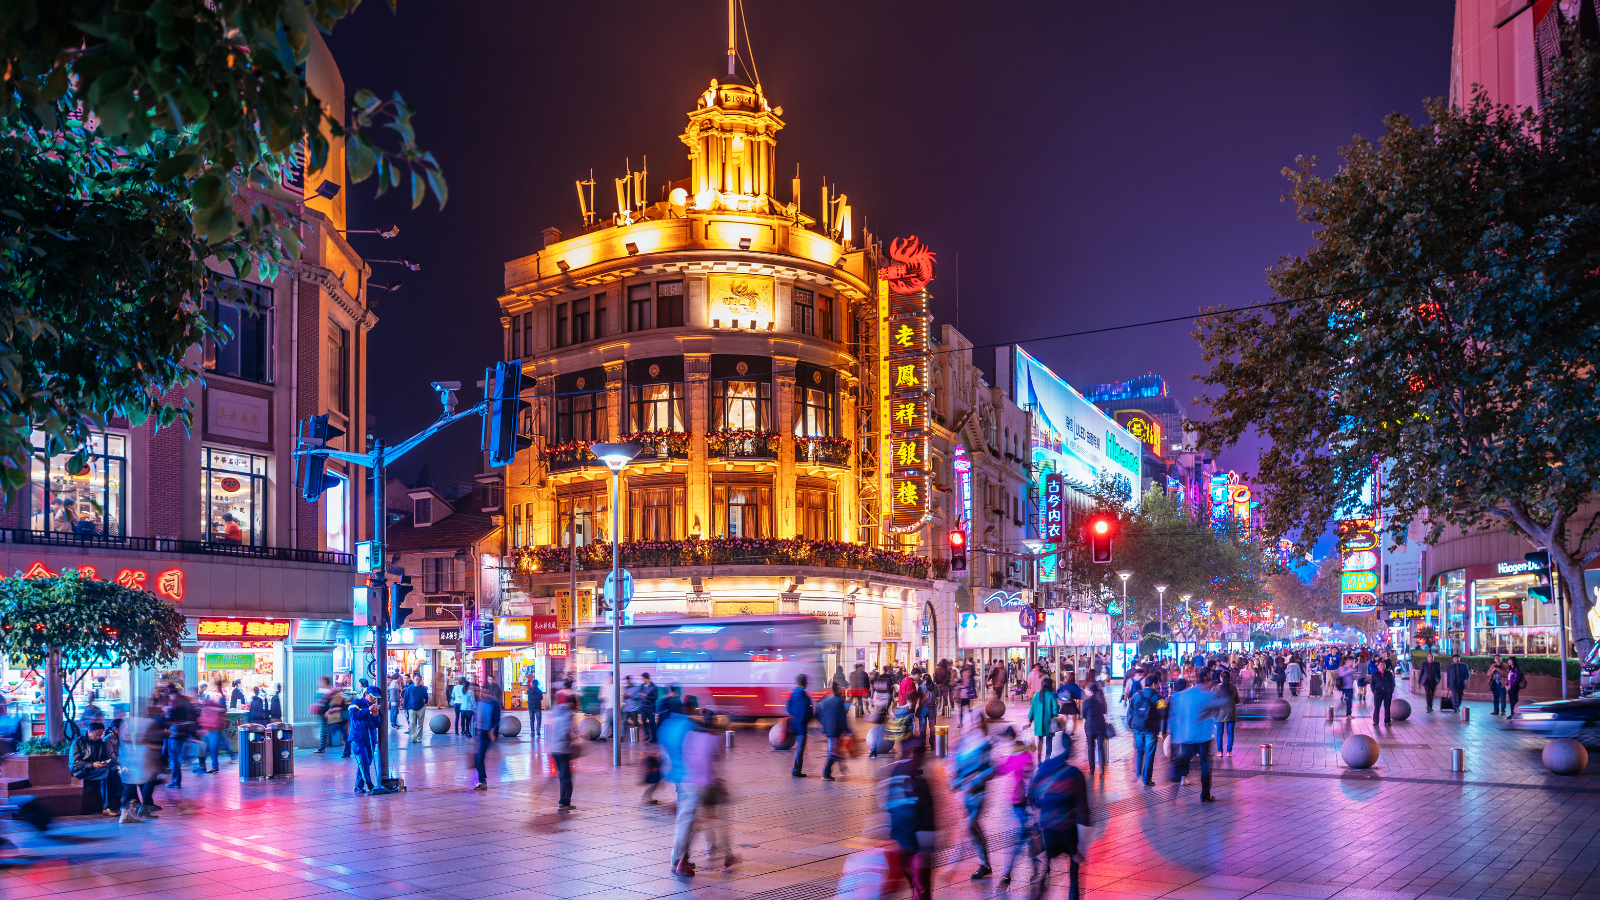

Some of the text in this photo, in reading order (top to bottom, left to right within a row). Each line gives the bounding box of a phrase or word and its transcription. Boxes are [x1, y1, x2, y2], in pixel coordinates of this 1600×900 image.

[895, 324, 920, 506] 老鳳祥銀樓
[1106, 430, 1139, 475] Hisense
[1047, 480, 1061, 537] 古今内衣
[1390, 609, 1440, 618] 新世界休
